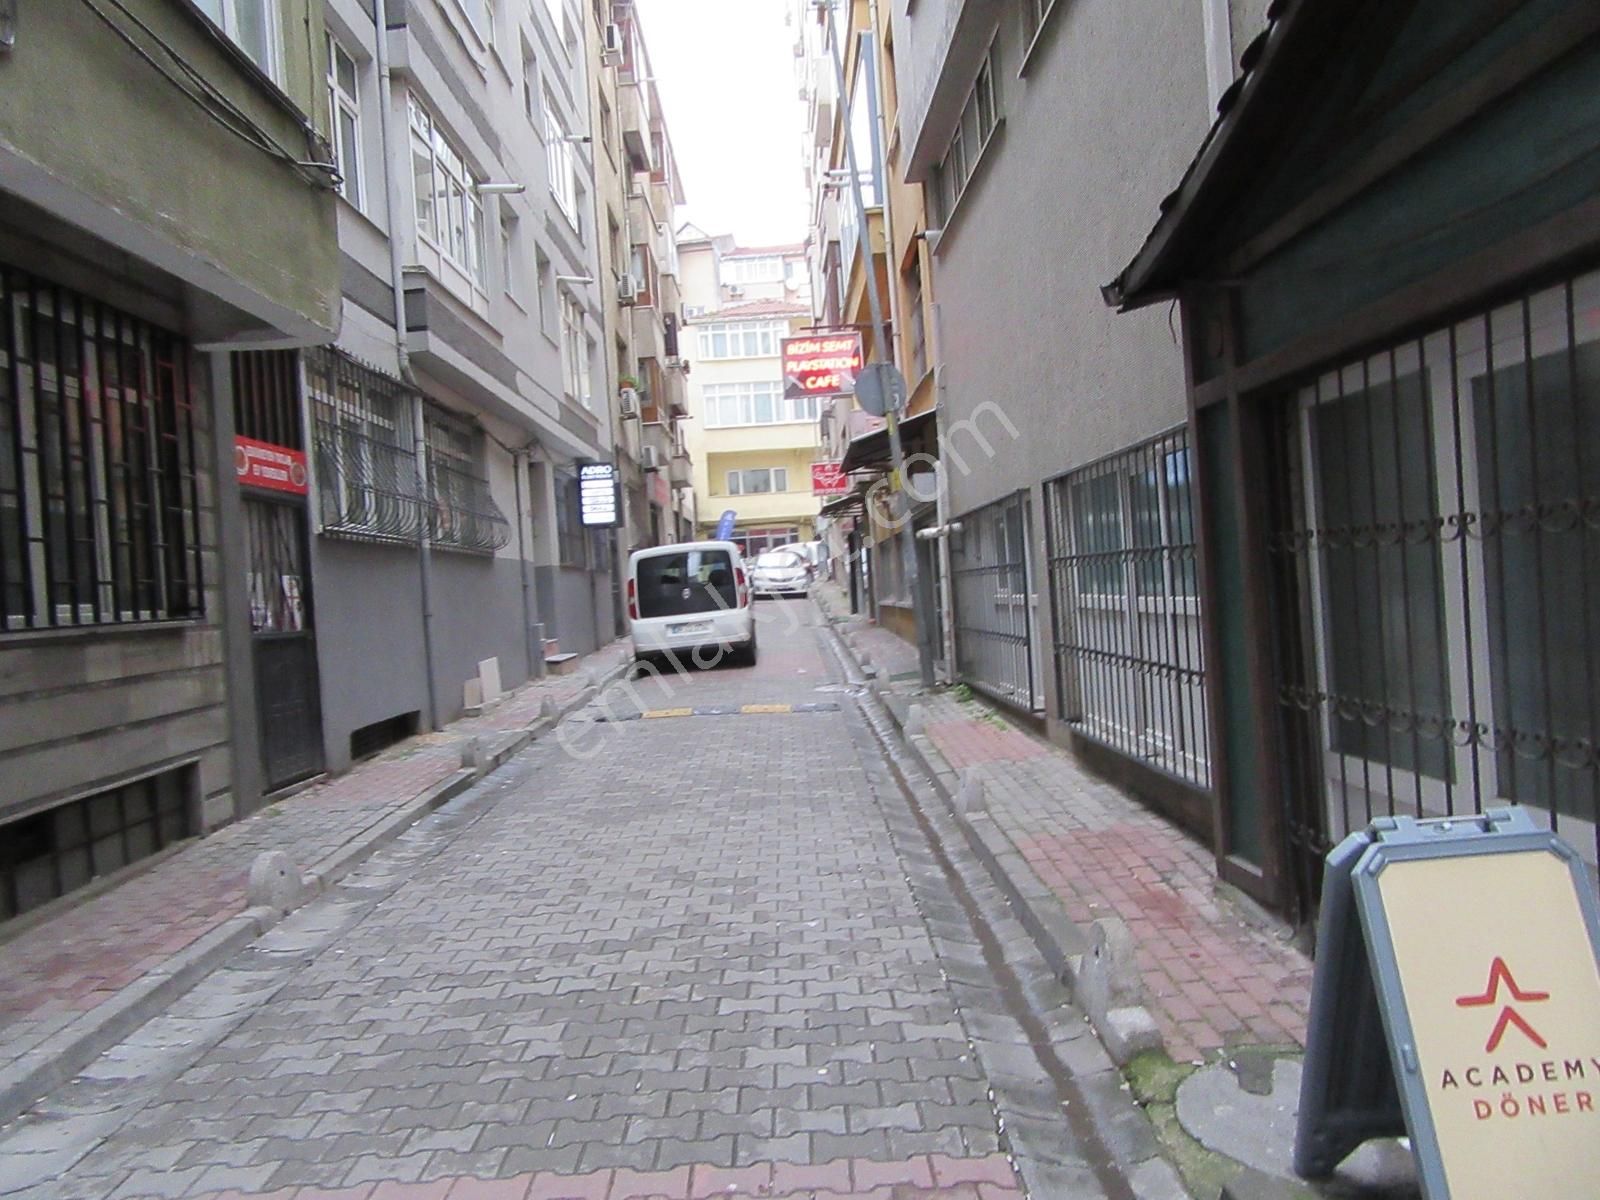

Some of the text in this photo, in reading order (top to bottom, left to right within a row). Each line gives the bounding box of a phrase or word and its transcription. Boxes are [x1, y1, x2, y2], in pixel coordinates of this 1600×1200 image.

[786, 339, 854, 356] BİZİM SEMT
[786, 357, 859, 372] PLAYSTATION
[806, 374, 840, 389] CAFE
[1473, 1091, 1594, 1120] DÖNER
